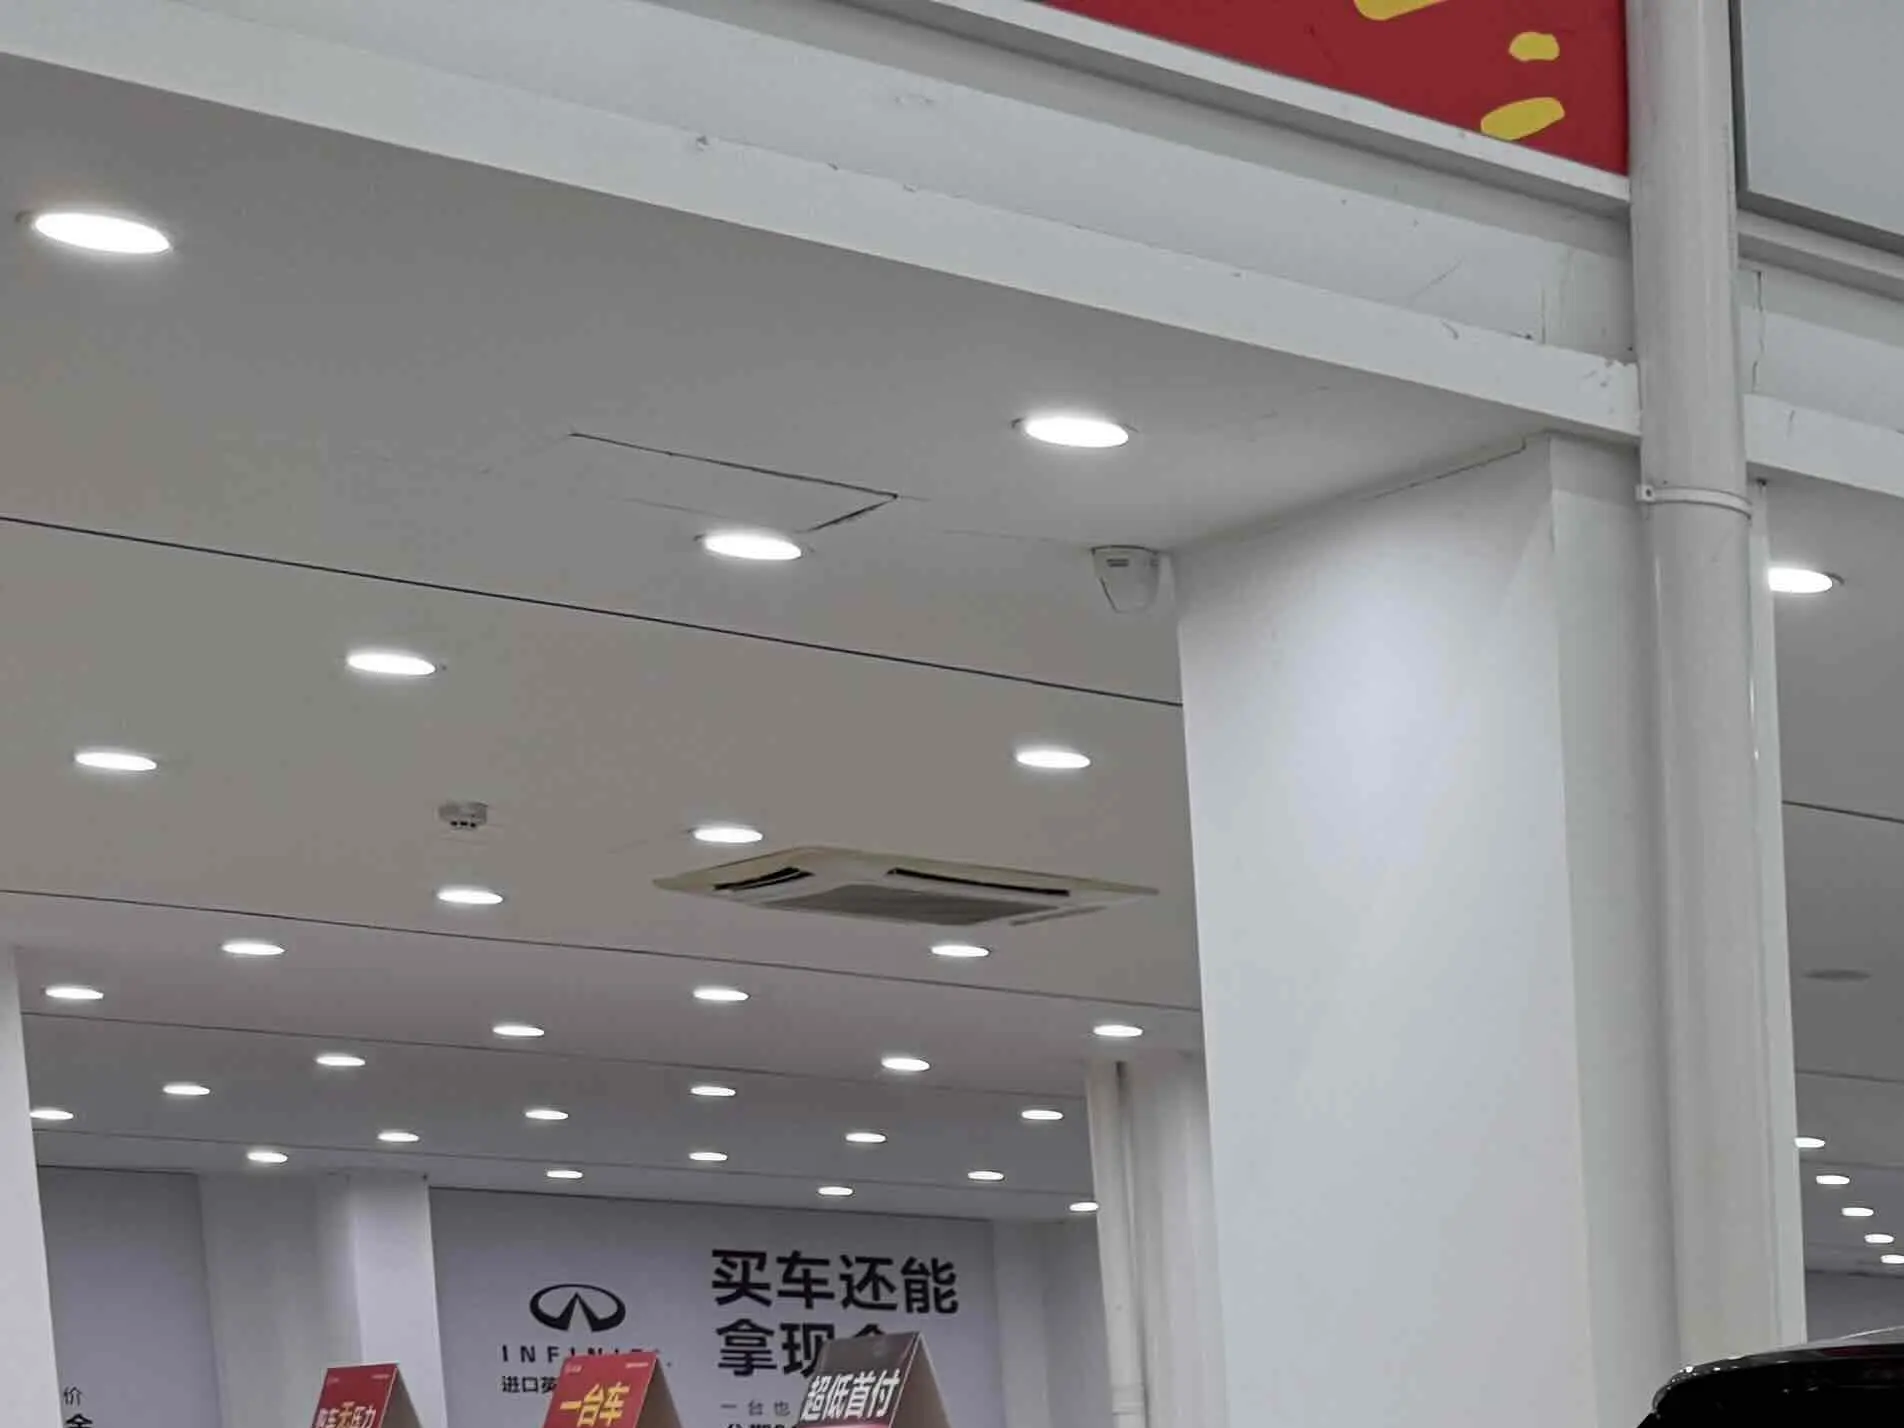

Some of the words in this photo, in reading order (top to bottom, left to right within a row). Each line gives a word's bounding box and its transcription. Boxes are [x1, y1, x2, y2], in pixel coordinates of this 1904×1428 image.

[711, 1248, 959, 1315] 买车还能
[715, 1318, 886, 1379] 拿现
[63, 1385, 82, 1406] 价
[559, 1381, 631, 1428] 一台车
[800, 1367, 900, 1422] 超低首付
